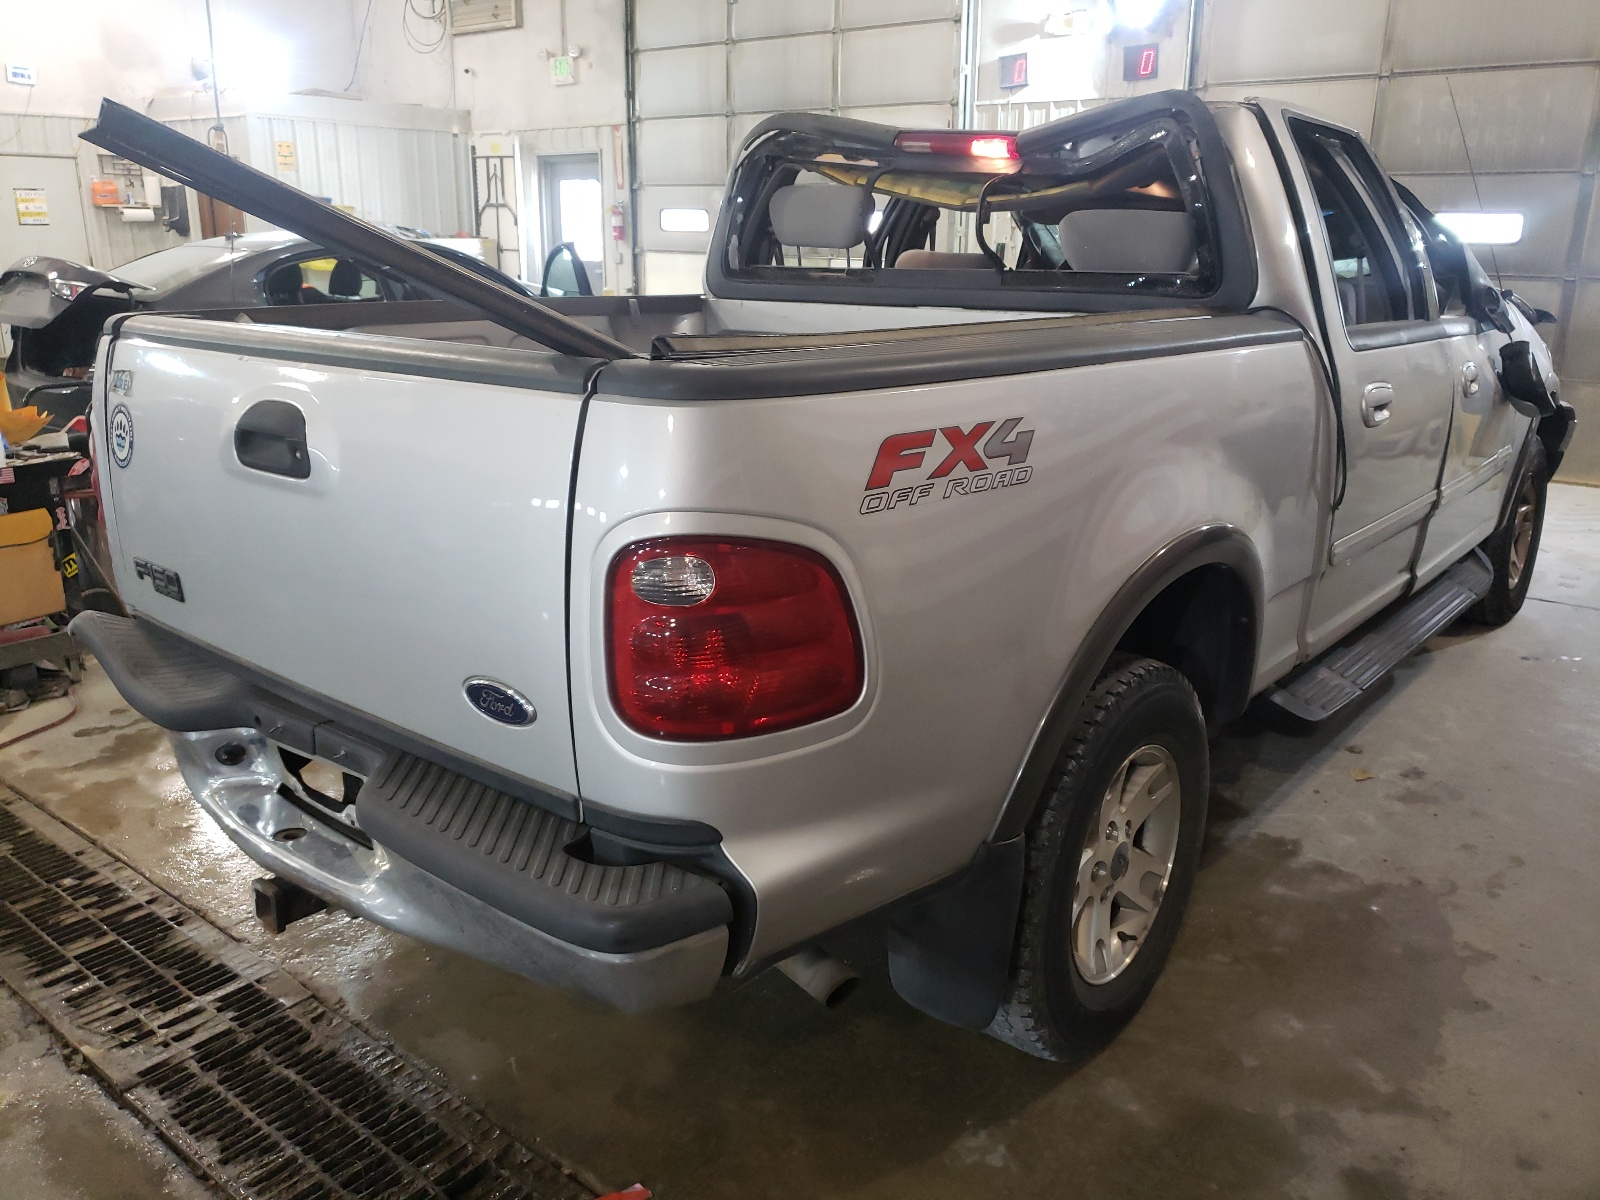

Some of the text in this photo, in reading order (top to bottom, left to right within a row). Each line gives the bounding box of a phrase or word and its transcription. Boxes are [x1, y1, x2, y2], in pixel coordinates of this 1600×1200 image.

[1140, 49, 1155, 76] 0
[864, 416, 1035, 492] FX4
[859, 465, 1034, 515] OFF ROAD
[480, 688, 515, 717] Ford
